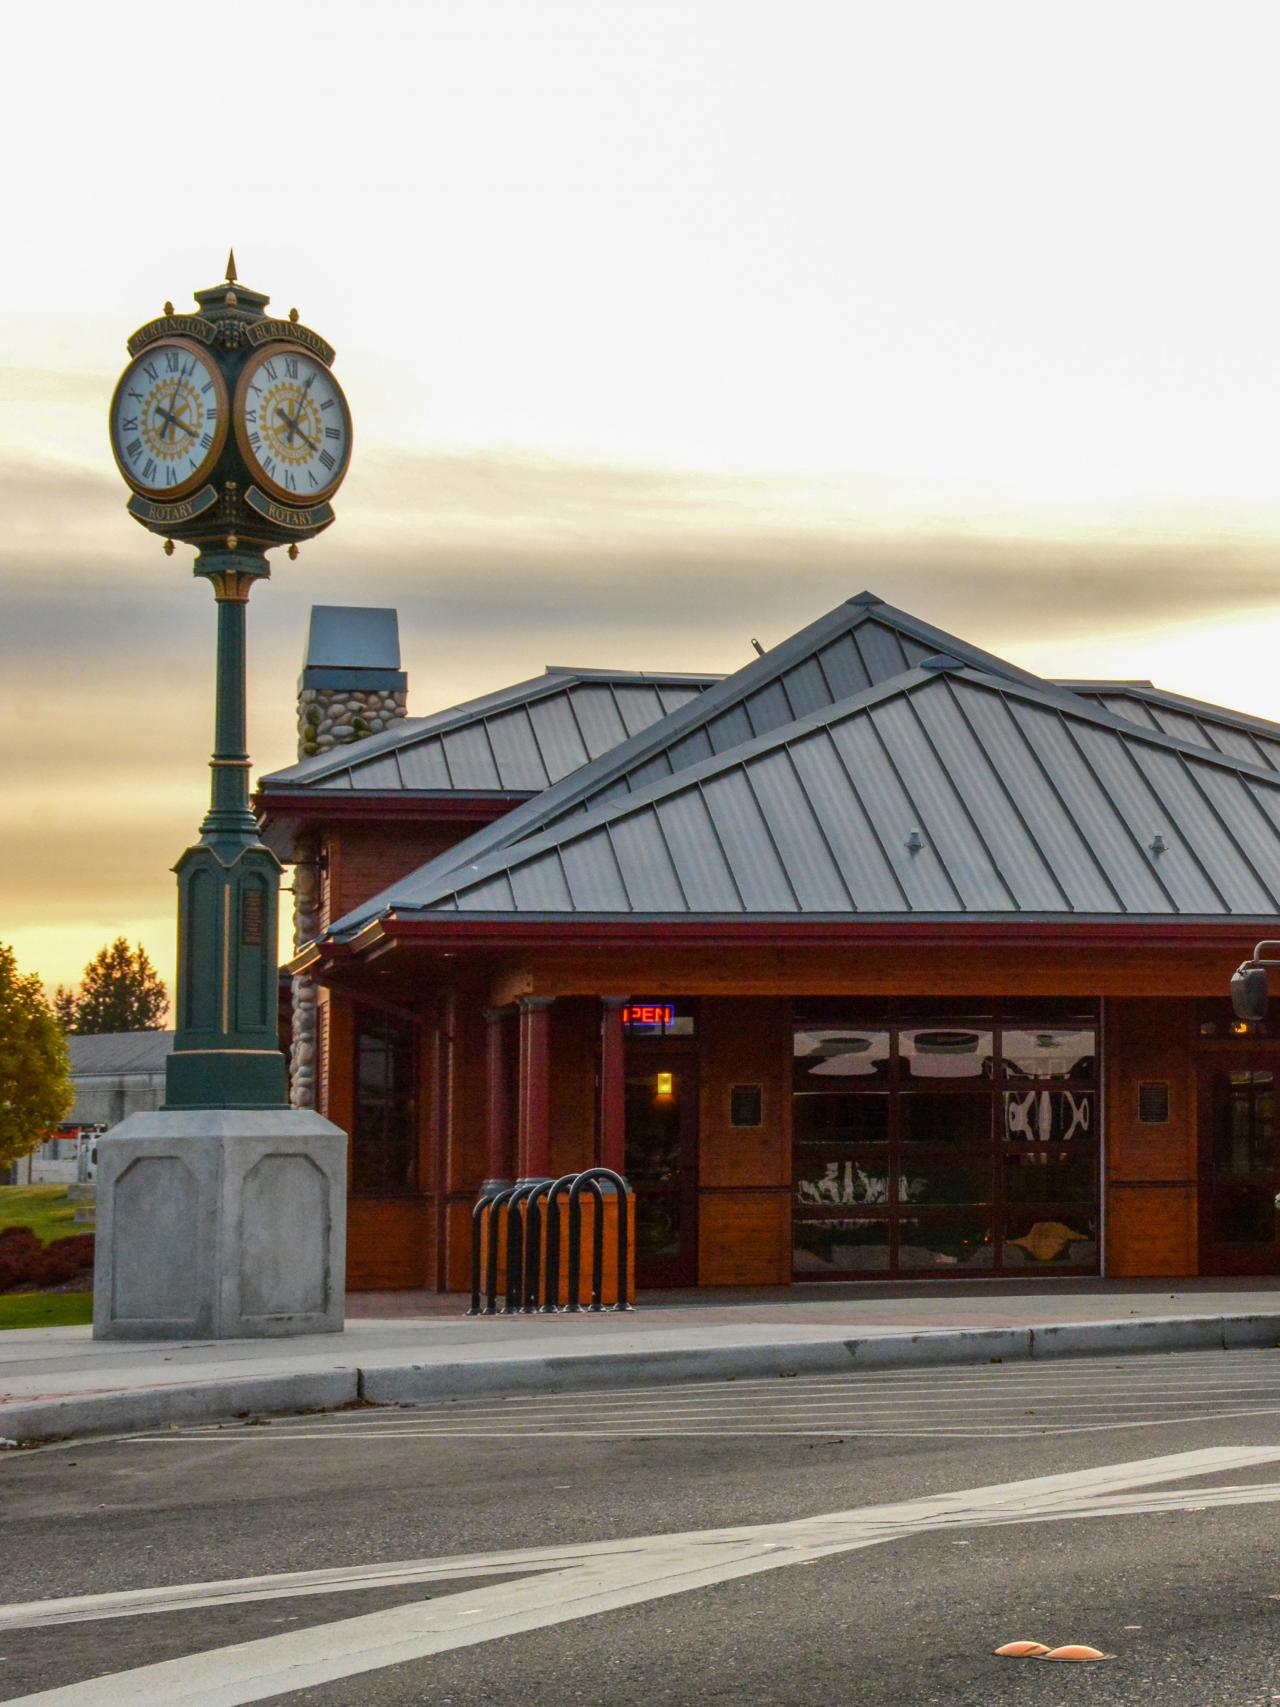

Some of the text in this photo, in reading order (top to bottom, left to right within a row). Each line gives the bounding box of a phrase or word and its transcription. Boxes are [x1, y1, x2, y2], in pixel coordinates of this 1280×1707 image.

[255, 322, 329, 357] BURLINGTON
[150, 502, 194, 519] ROTARY
[268, 504, 313, 524] ROTARY
